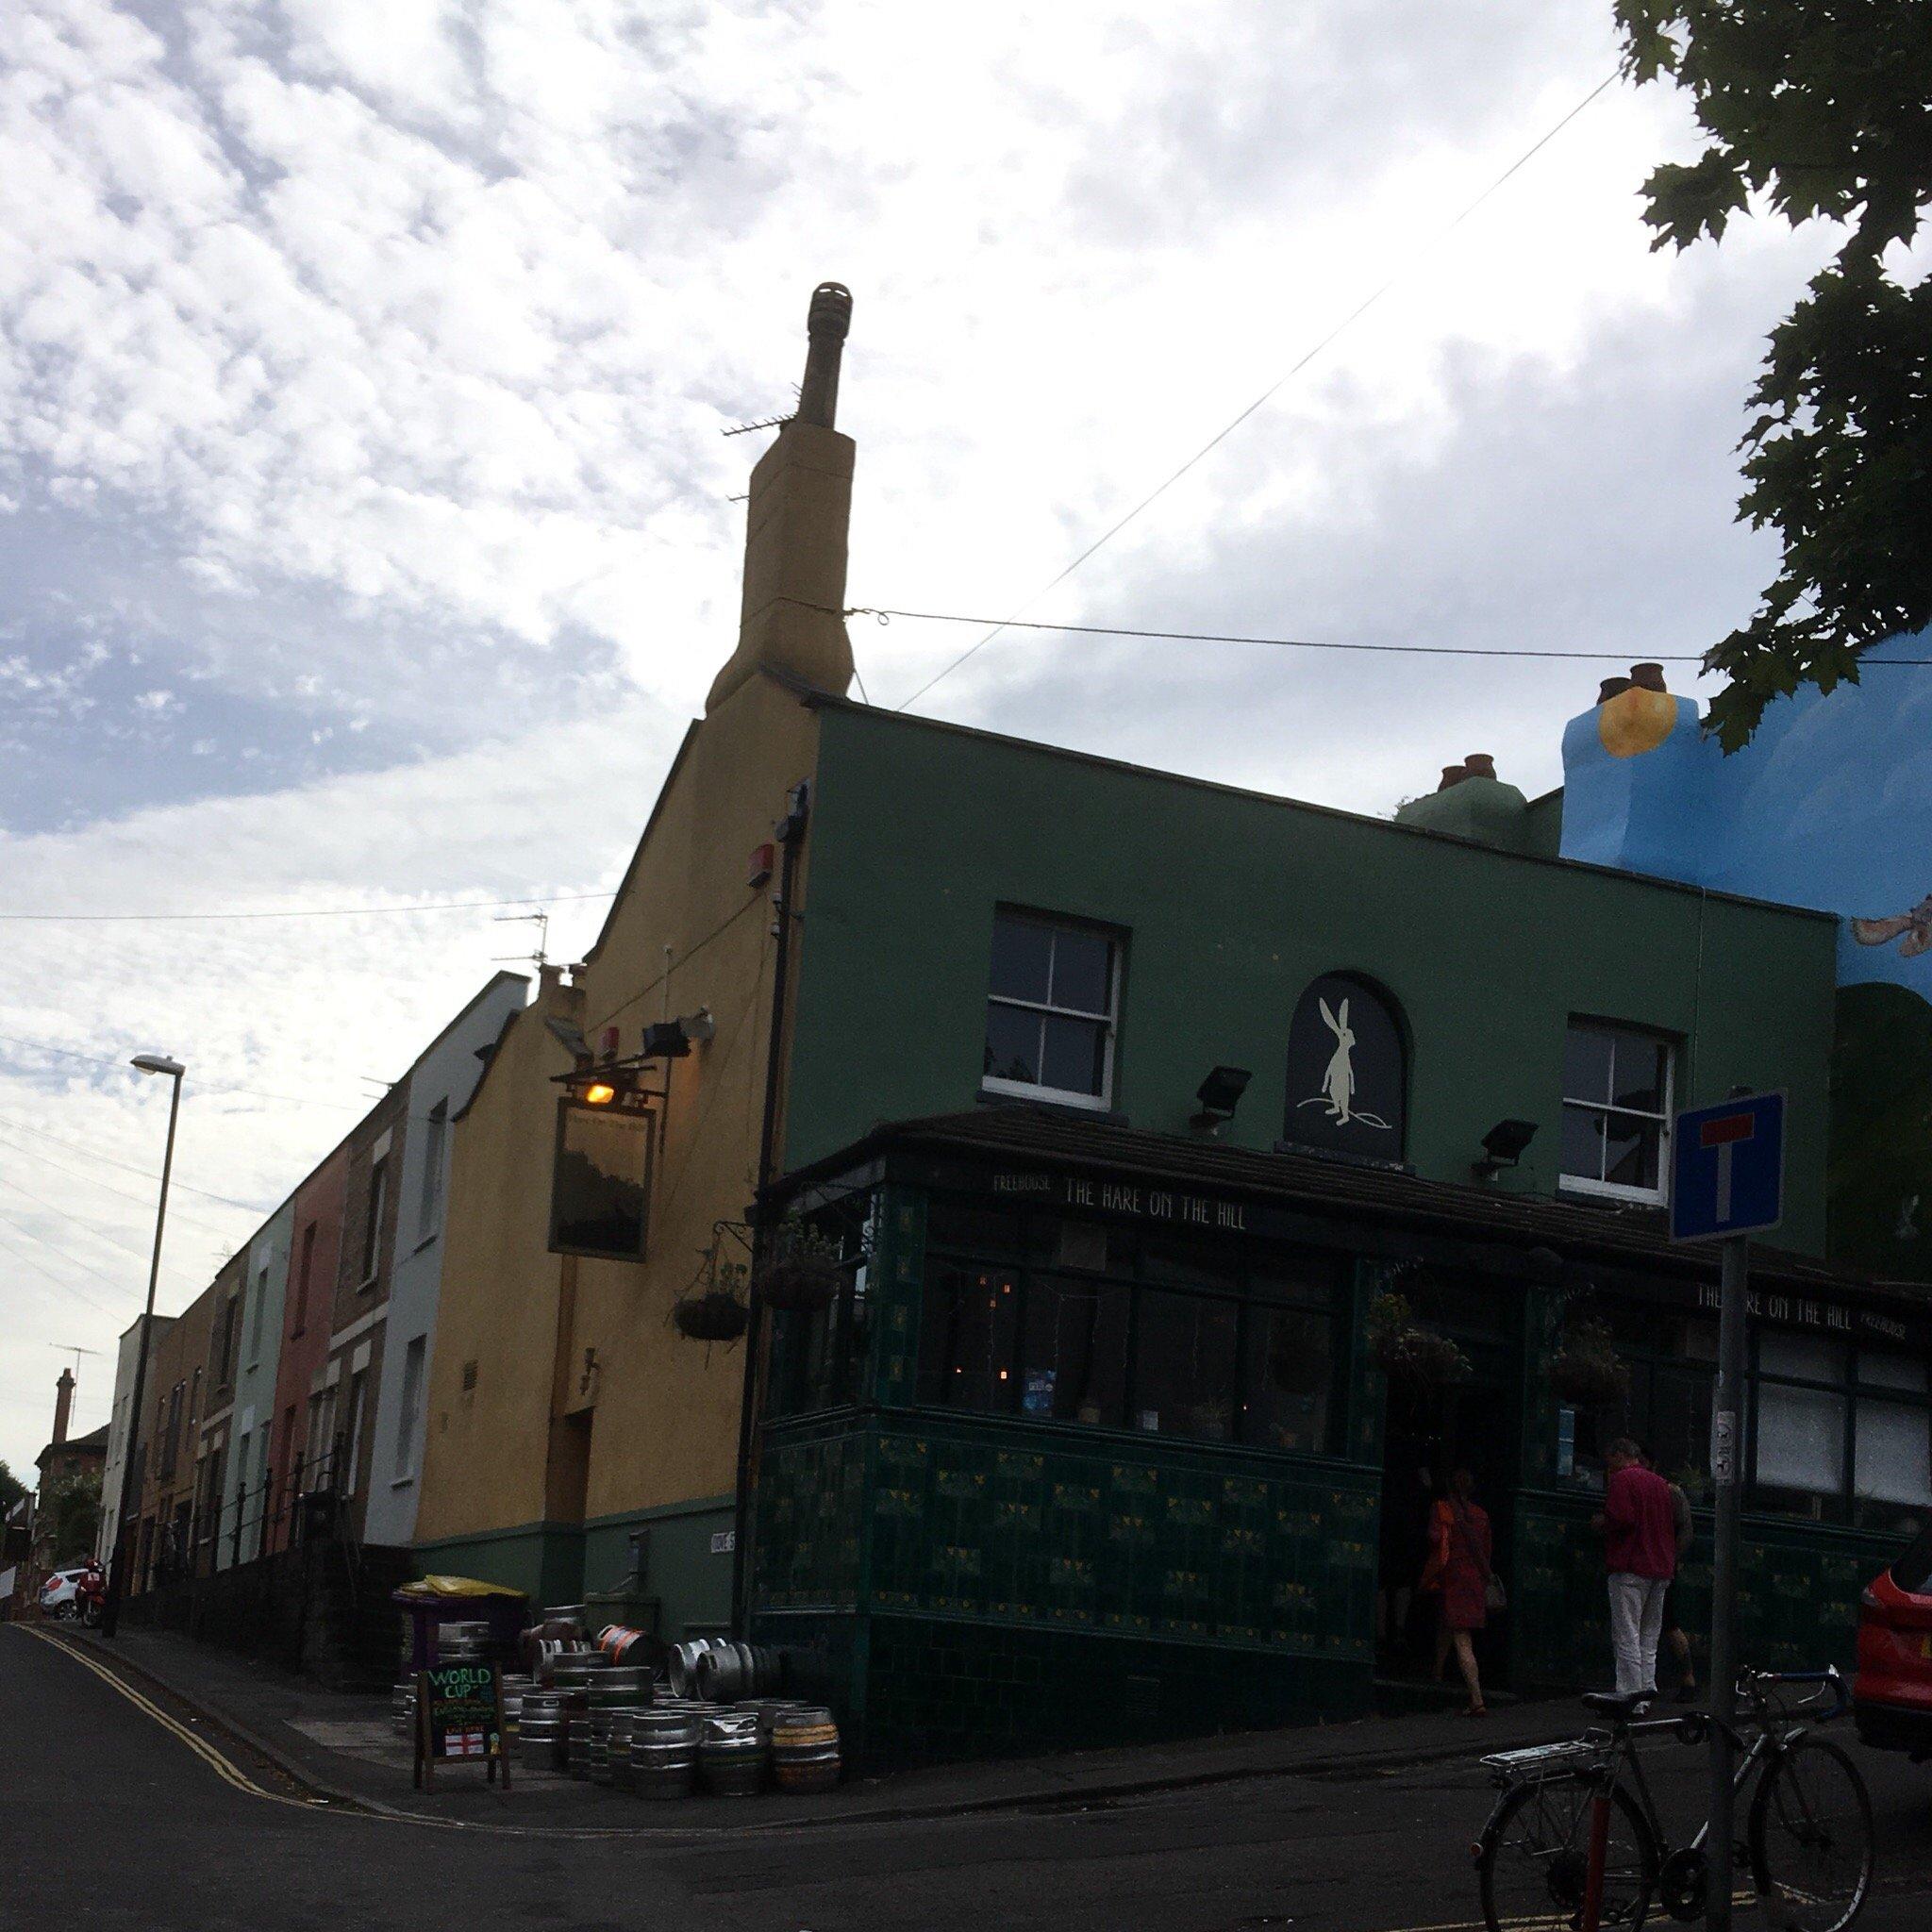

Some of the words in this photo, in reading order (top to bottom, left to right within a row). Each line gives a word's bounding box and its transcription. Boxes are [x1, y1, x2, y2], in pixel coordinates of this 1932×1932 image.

[1066, 1177, 1094, 1207] THE
[1102, 1184, 1141, 1214] HARE
[1149, 1191, 1173, 1219] ON
[1182, 1196, 1209, 1224] THE
[1217, 1201, 1246, 1230] HILL
[1698, 1283, 1722, 1308] THE
[1768, 1297, 1790, 1321] ON
[1796, 1298, 1821, 1325] THE
[1826, 1304, 1852, 1330] HILL
[427, 1667, 491, 1686] WORLD
[444, 1684, 472, 1699] CUP
